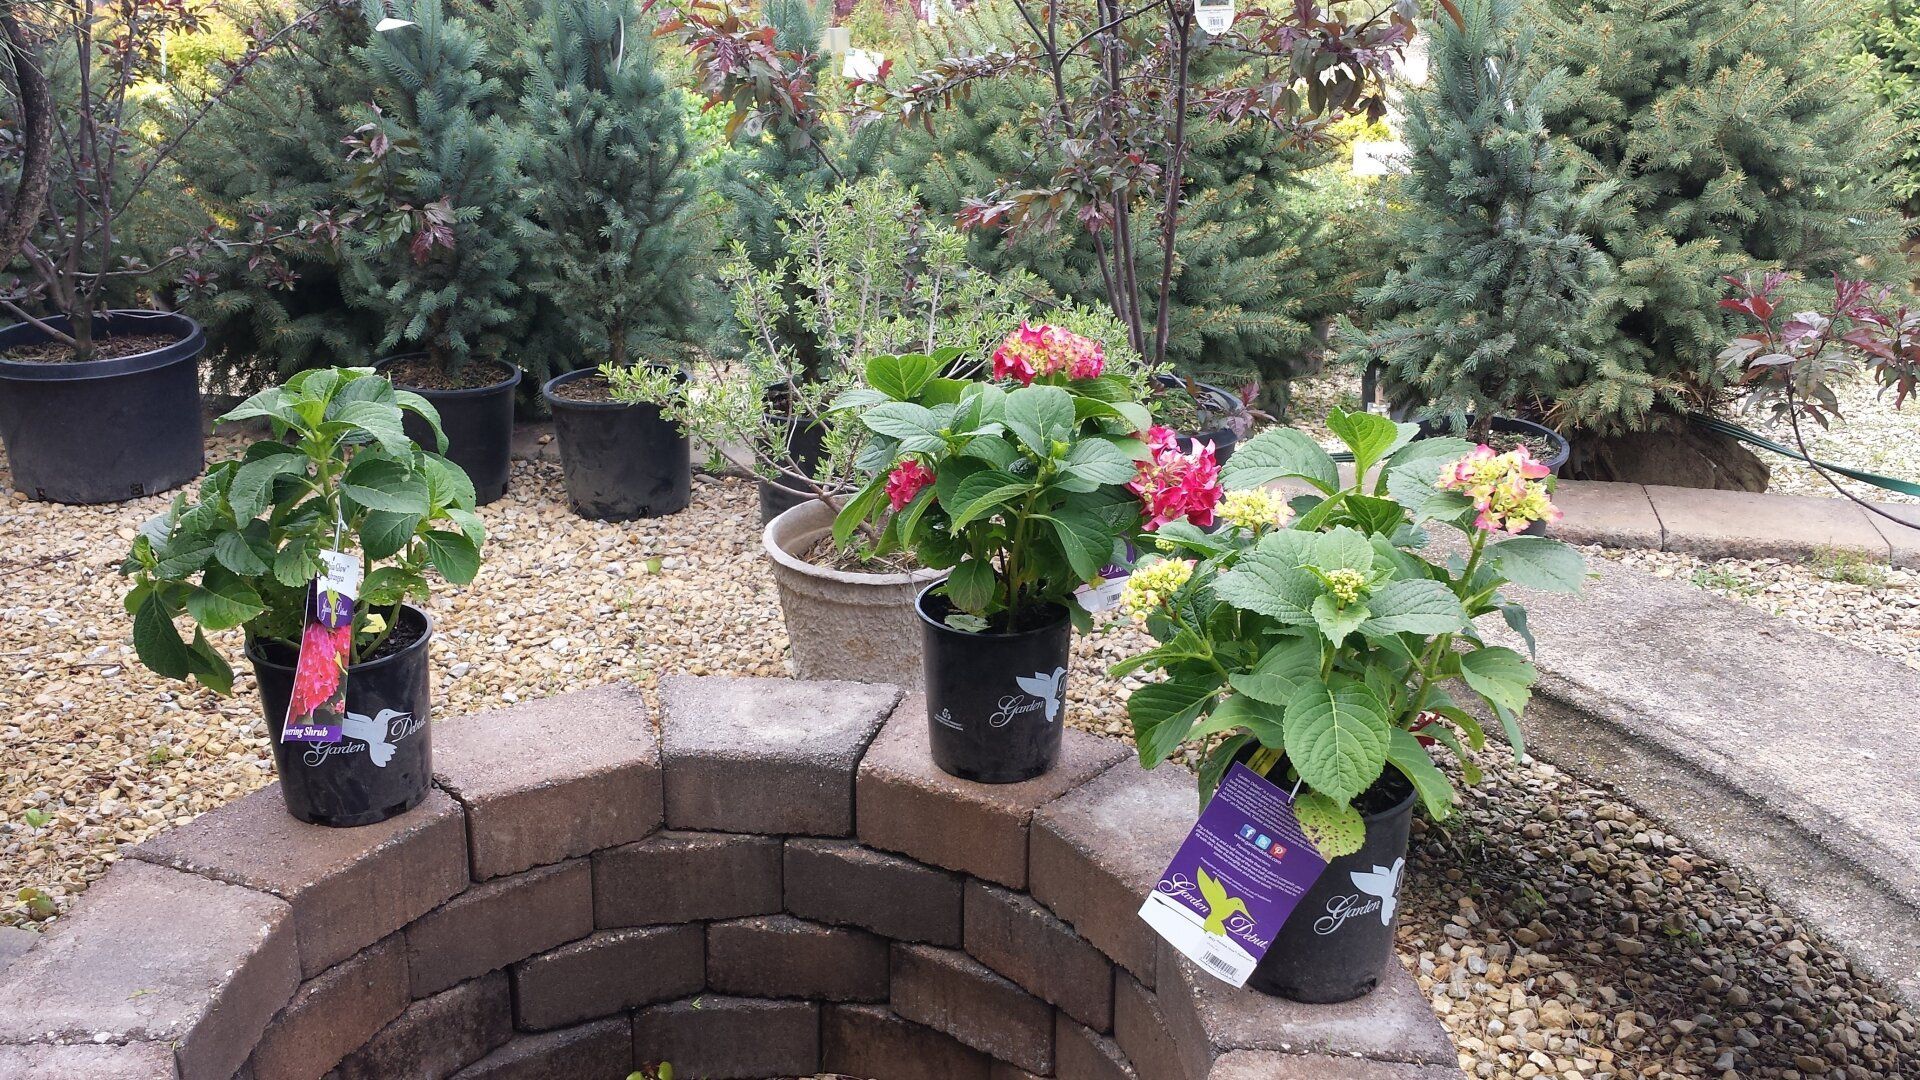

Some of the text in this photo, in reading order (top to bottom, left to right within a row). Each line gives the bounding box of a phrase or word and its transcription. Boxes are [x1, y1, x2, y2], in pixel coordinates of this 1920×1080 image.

[989, 694, 1044, 728] Garden
[303, 714, 426, 768] Garden Debut
[304, 726, 328, 738] Shrub
[1234, 833, 1281, 864] www.gardendebut.com
[1158, 872, 1210, 912] Garden
[1226, 914, 1268, 949] Debut
[1314, 894, 1380, 935] Garden
